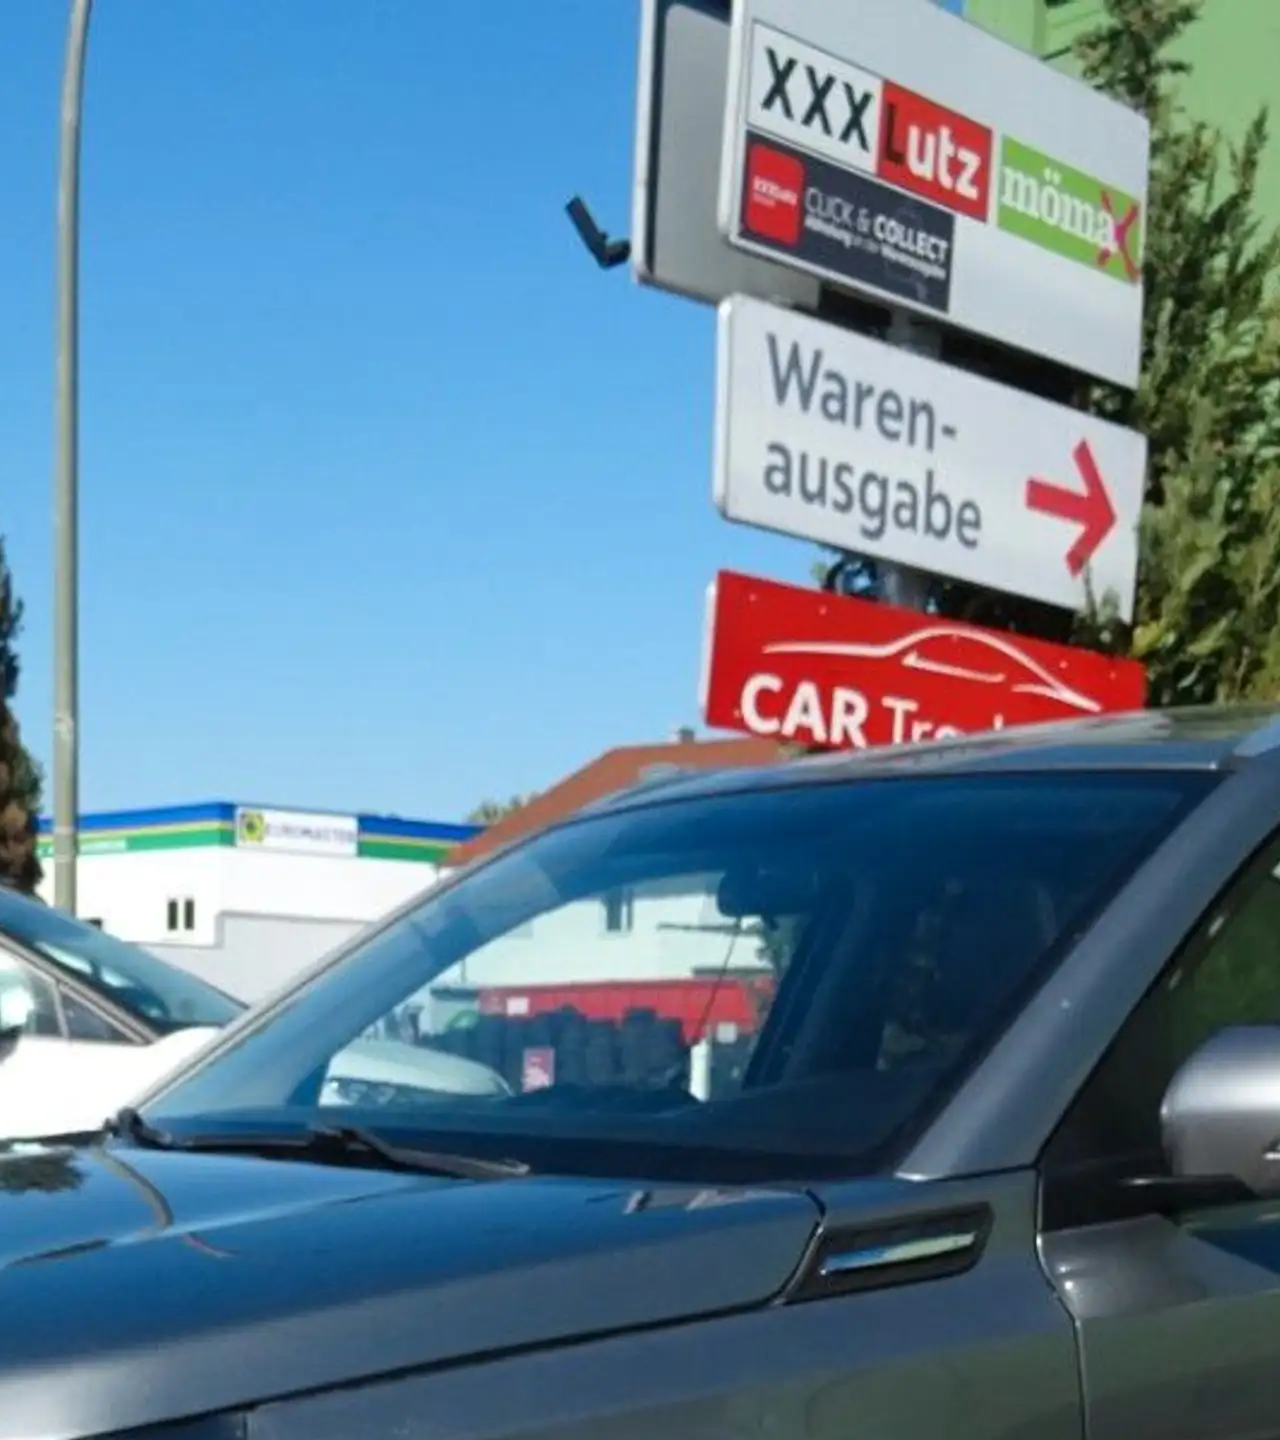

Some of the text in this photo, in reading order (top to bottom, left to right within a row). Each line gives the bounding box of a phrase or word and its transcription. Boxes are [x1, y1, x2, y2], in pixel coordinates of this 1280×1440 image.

[873, 214, 949, 263] COLLECT
[766, 331, 958, 453] Waren-
[763, 441, 983, 550] ausgabe
[741, 672, 868, 749] CAR
